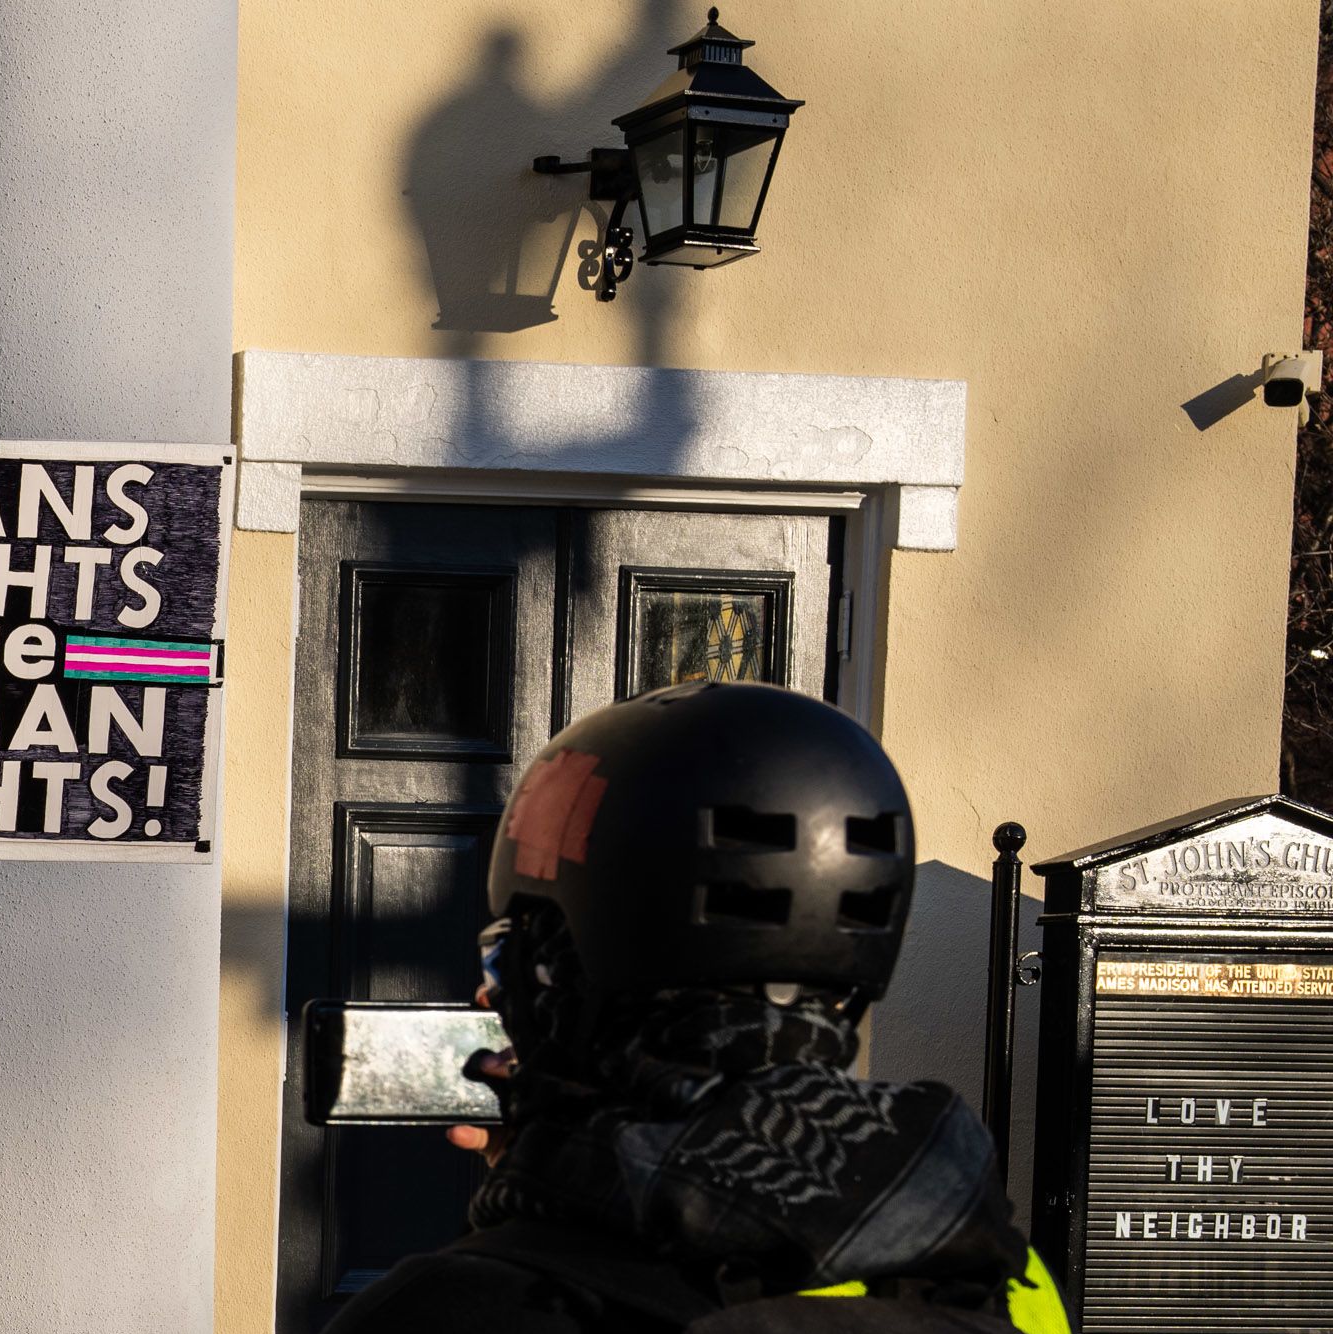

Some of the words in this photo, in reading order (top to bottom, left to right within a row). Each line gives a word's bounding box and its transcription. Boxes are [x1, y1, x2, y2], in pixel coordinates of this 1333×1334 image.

[1119, 856, 1158, 892] ST.
[1164, 836, 1271, 877] JOHN'S
[1158, 881, 1265, 898] PROTESTANT
[1131, 963, 1199, 977] PRESIDENT
[1205, 964, 1222, 977] OF
[1227, 965, 1252, 978] THE
[1138, 978, 1199, 991] MADISON
[1205, 979, 1228, 993] HAS
[1231, 980, 1293, 994] ATTENDED
[1146, 1097, 1268, 1126] LOVE
[1167, 1155, 1244, 1183] THY
[1115, 1211, 1307, 1241] NEIGHBOR
